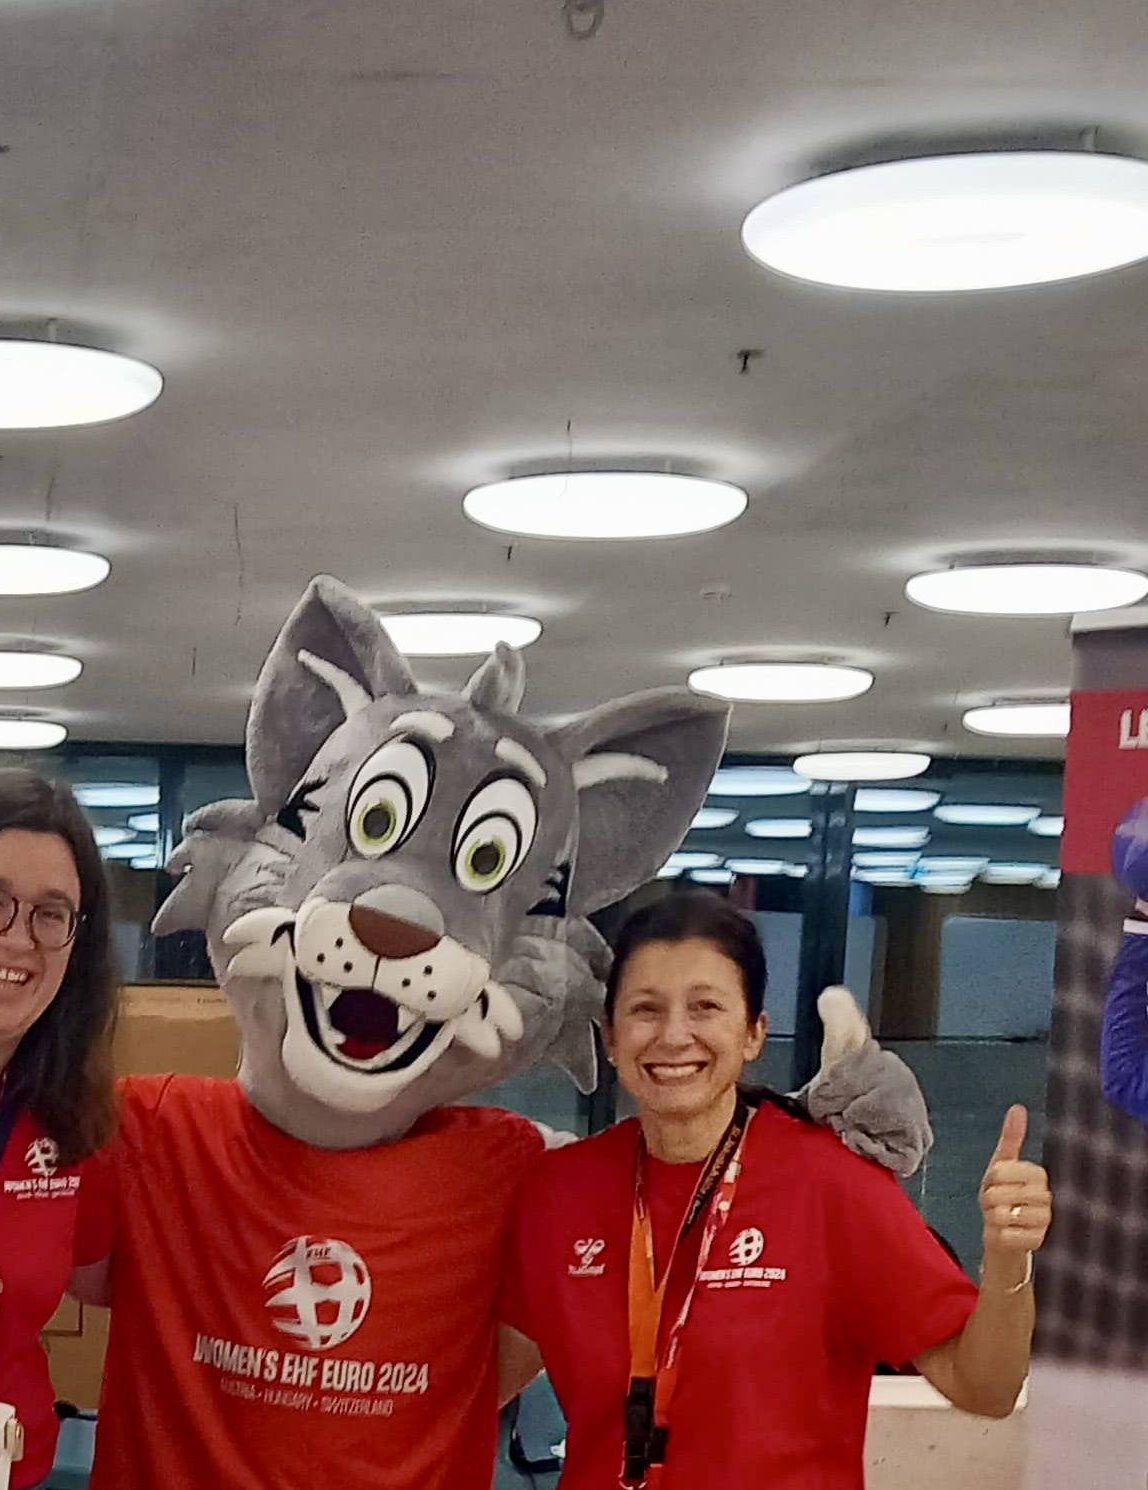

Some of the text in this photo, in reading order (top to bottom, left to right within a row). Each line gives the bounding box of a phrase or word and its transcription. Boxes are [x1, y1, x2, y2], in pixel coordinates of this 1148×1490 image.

[193, 1332, 429, 1396] WOMEN'S EHF EURO 2024
